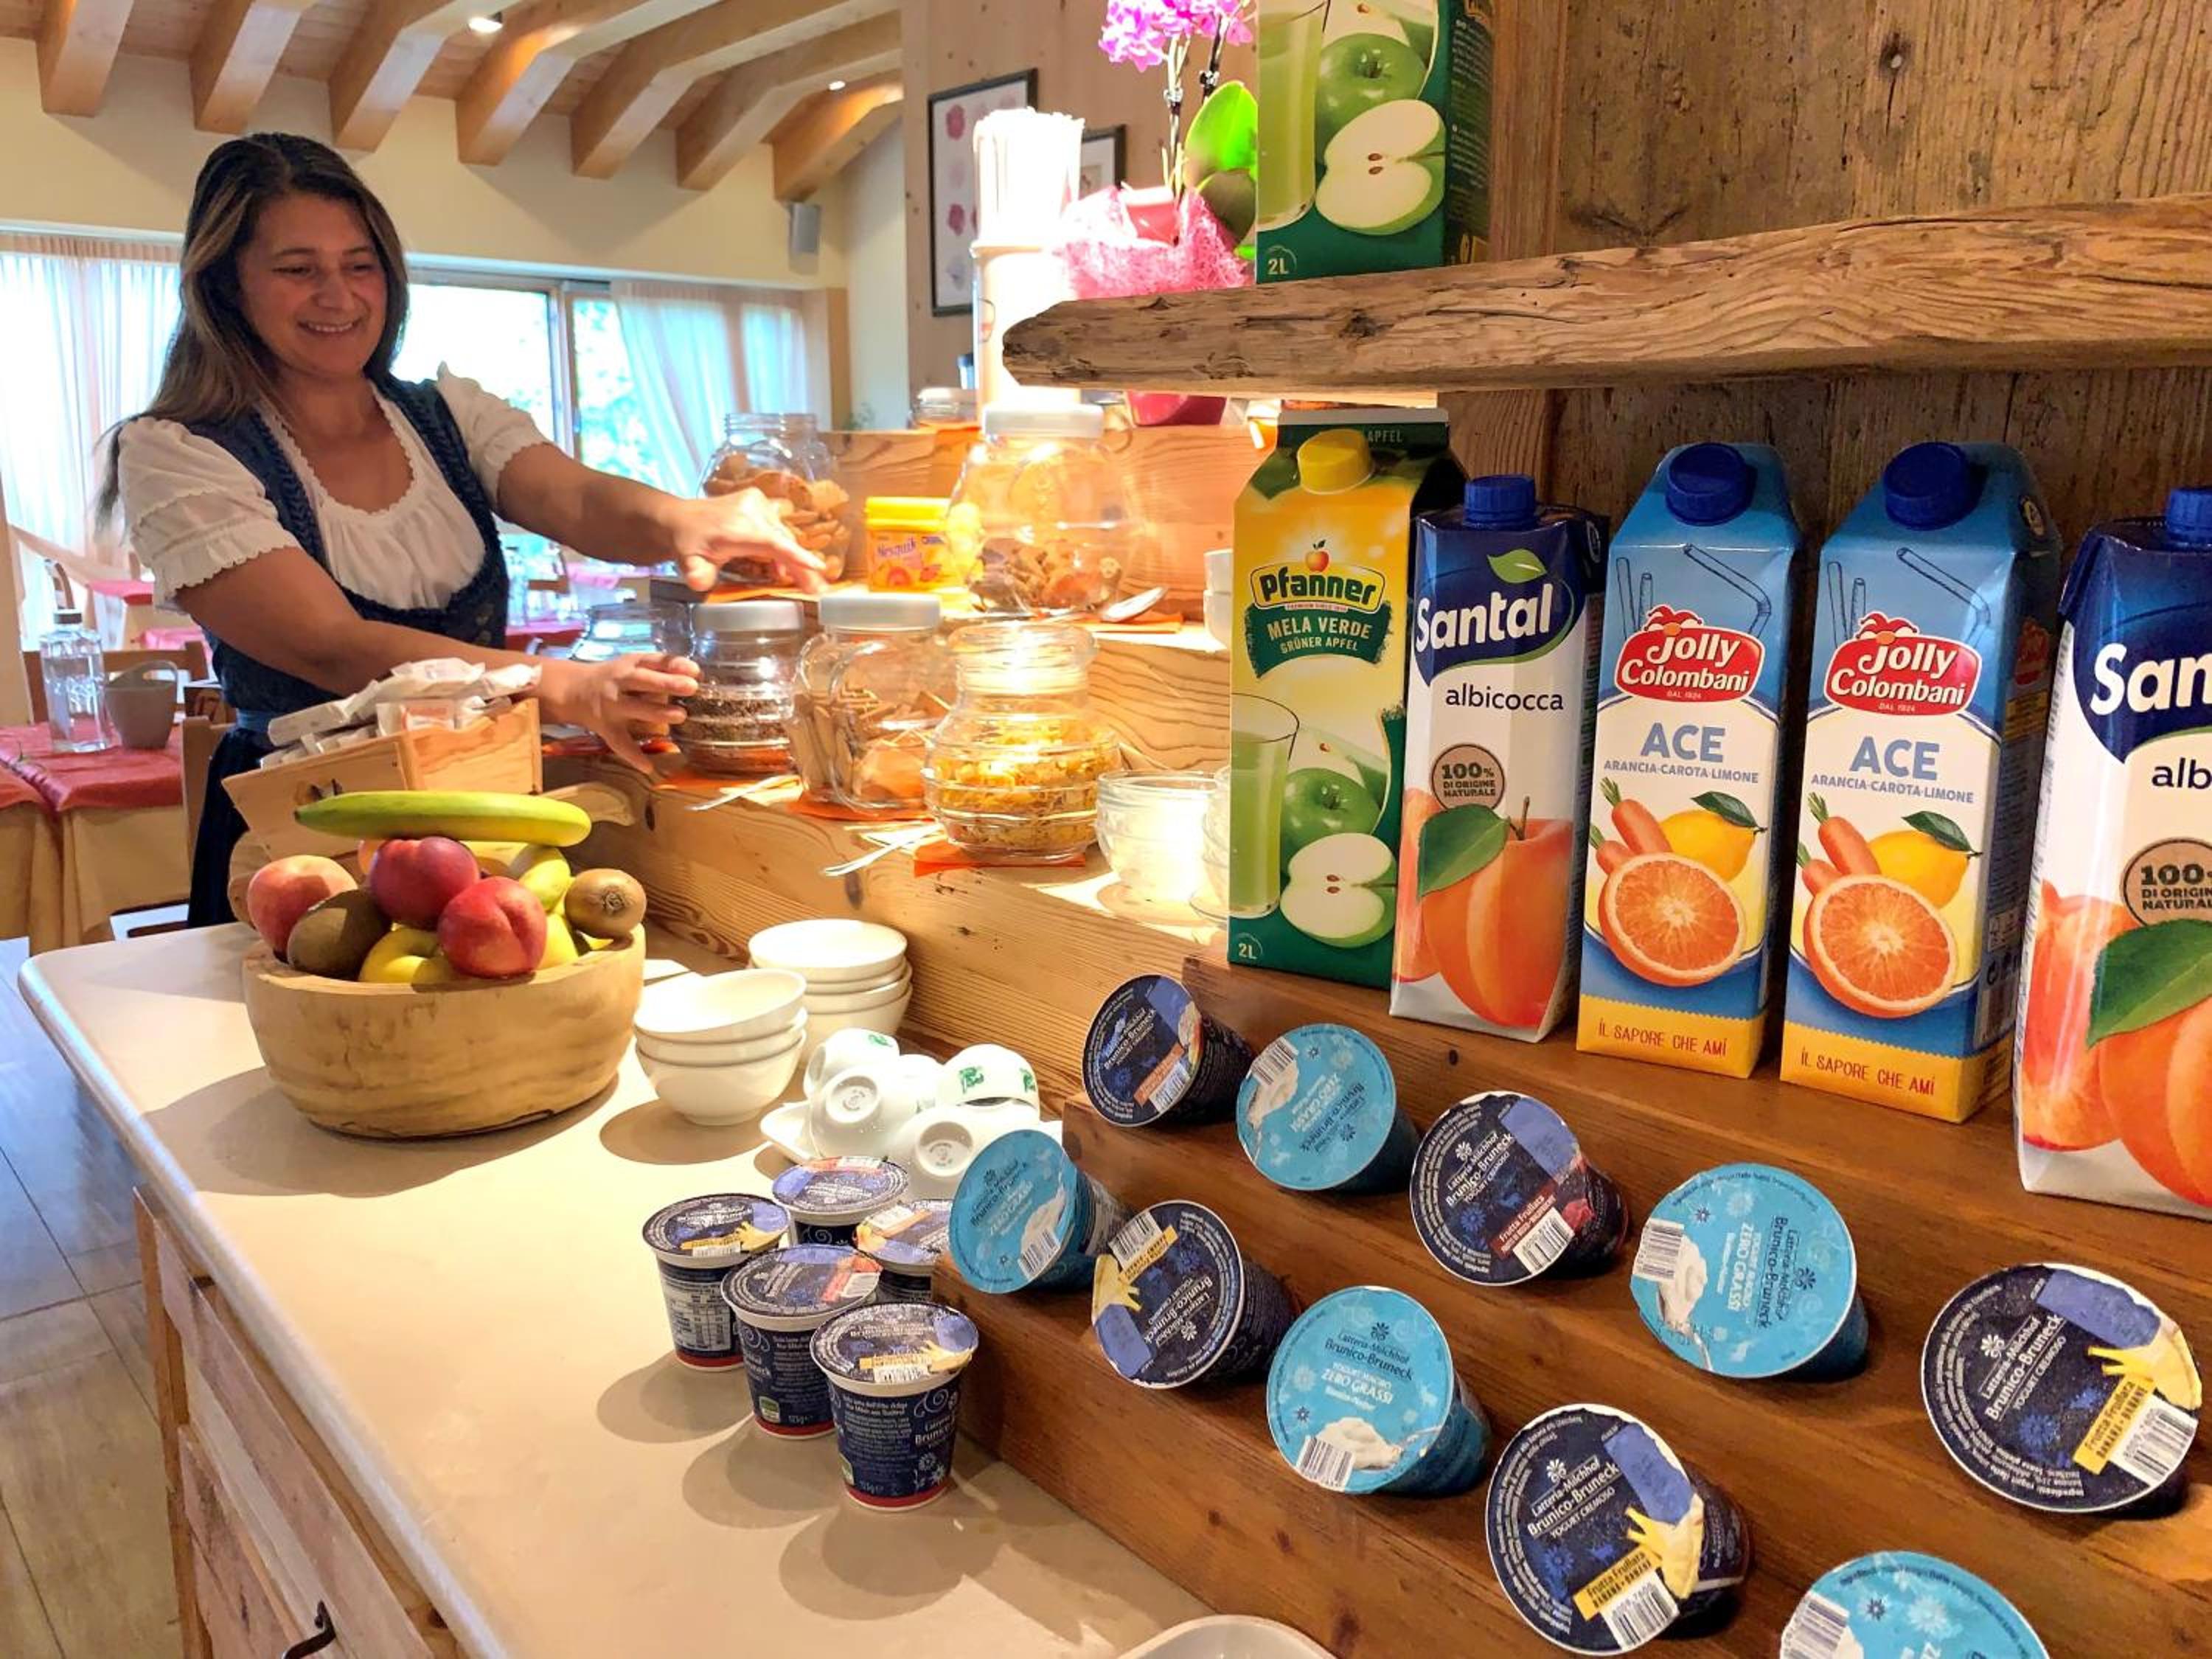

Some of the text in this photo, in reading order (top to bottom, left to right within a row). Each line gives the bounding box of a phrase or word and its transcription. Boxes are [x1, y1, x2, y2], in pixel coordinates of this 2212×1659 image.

[1267, 258, 1289, 276] 2L
[1367, 429, 1403, 443] APFEL
[1259, 566, 1377, 605] Pfanner
[1267, 616, 1373, 641] MELA VERDE
[1415, 582, 1554, 653] Santal
[1280, 636, 1358, 654] GRÜNER APFEL
[1646, 633, 1741, 668] Jolly
[1857, 642, 1958, 679] Jolly
[1621, 658, 1750, 692] Colombani
[1830, 668, 1966, 706] Colombani
[1445, 682, 1564, 711] albicocca
[1641, 722, 1726, 763] ACE
[1849, 735, 1940, 781] ACE
[1444, 788, 1496, 798] NATURALE
[1455, 780, 1495, 789] ORIGINE
[1238, 942, 1257, 959] 2L
[1614, 1024, 1664, 1047] SAPORE
[1672, 1034, 1698, 1052] CHE
[1816, 1054, 1870, 1080] SAPORE
[1877, 1068, 1905, 1089] CHE
[1324, 1338, 1414, 1381] Brunico-Bruneck
[1984, 1311, 2062, 1420] Brunico-Bruneck
[2011, 1334, 2067, 1411] YOGURT CREMOSO
[1526, 1460, 1620, 1537] Brunico-Bruneck
[1550, 1512, 1582, 1539] YOGURT
